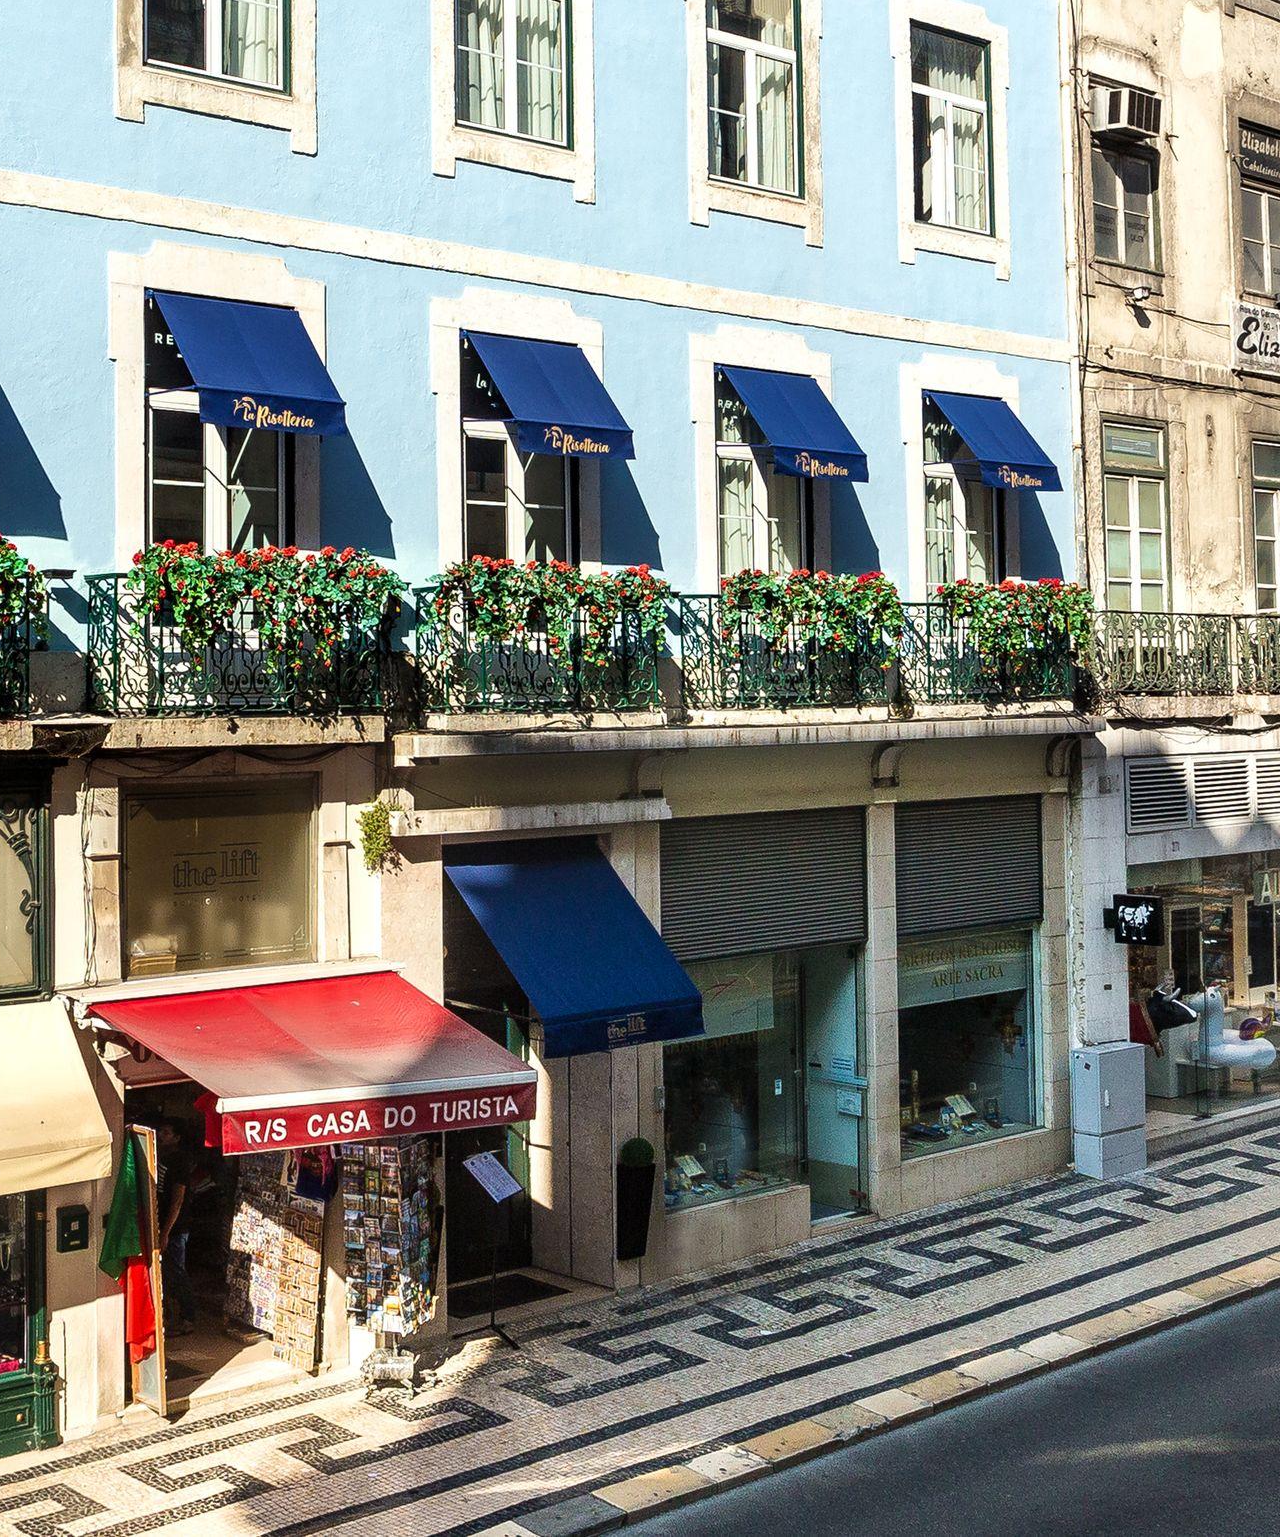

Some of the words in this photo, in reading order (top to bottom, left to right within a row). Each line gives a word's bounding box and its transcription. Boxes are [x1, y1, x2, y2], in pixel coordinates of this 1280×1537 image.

[475, 373, 487, 389] La
[256, 404, 315, 429] Risotteria
[562, 433, 611, 455] Risotteria
[810, 458, 850, 478] Risotteria
[172, 860, 217, 888] the
[219, 848, 260, 878] lift
[931, 969, 963, 988] ARTE
[965, 965, 1005, 983] SACRA
[244, 1118, 287, 1145] R/S
[306, 1109, 371, 1138] CASA
[384, 1105, 416, 1129] DO
[429, 1095, 519, 1124] TURISTA
